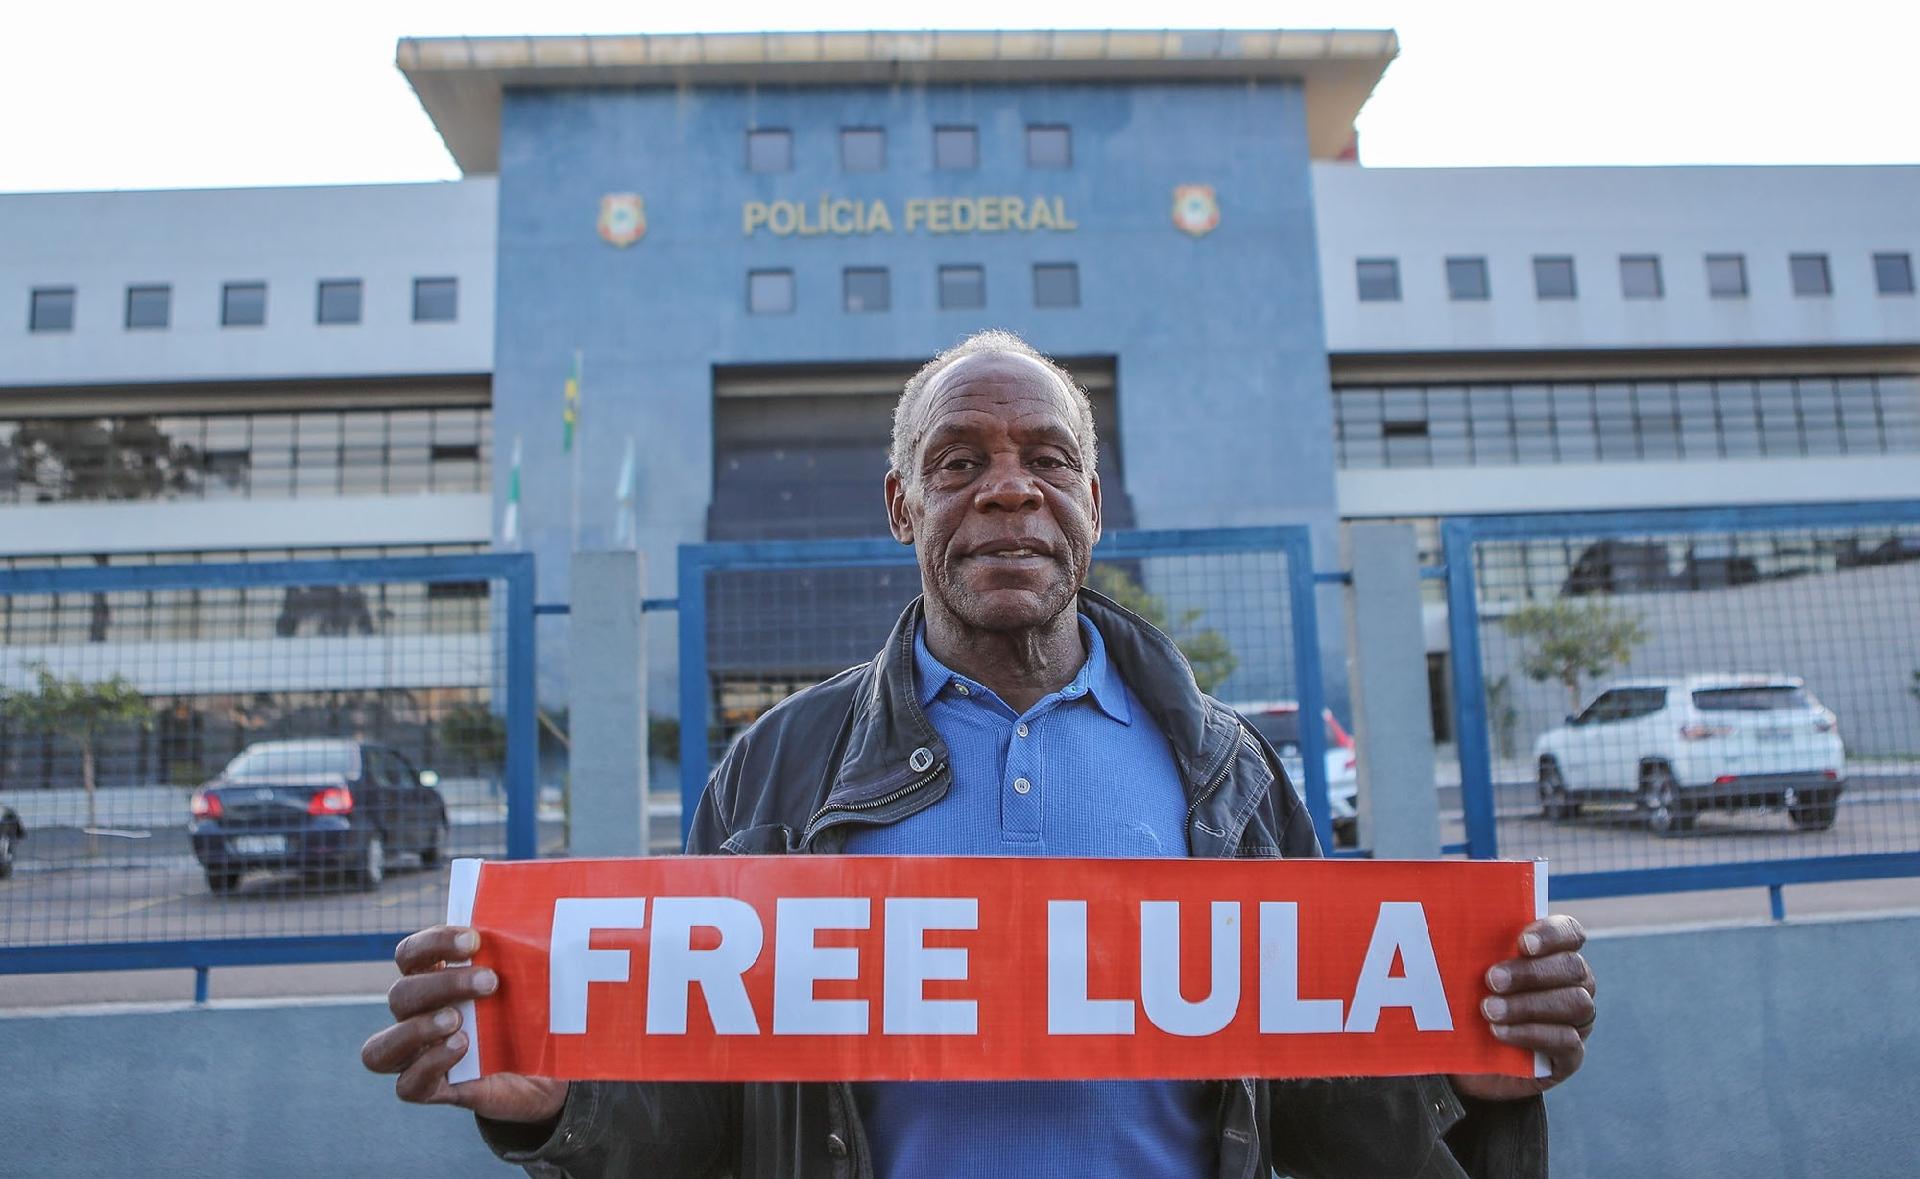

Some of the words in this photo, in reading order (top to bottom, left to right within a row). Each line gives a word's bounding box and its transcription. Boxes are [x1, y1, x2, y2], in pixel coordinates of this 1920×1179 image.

[743, 194, 892, 236] POLÍCIA
[905, 197, 1077, 232] FEDERAL
[549, 897, 979, 1036] FREE
[1047, 900, 1454, 1036] LULA
